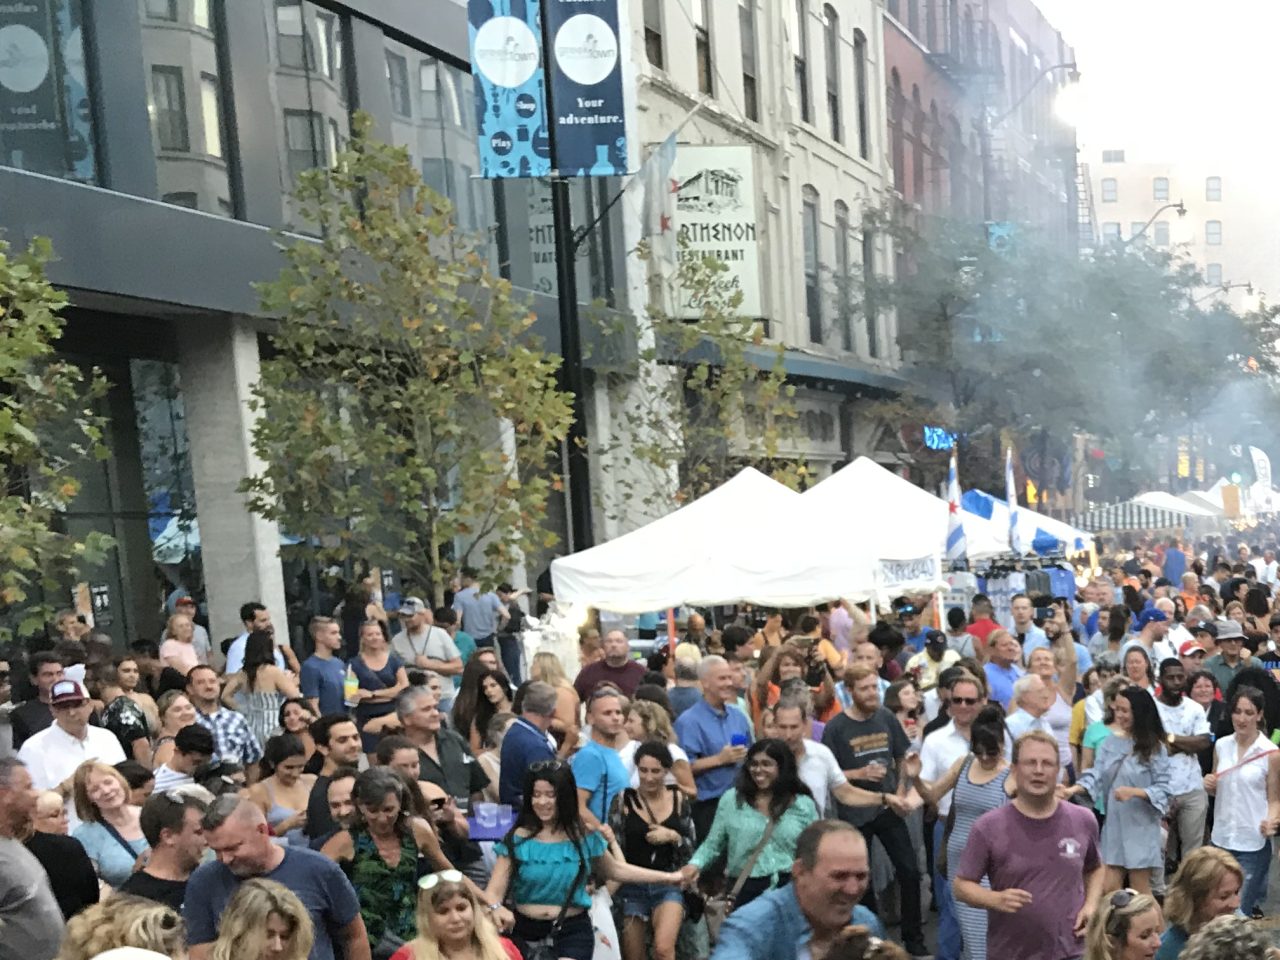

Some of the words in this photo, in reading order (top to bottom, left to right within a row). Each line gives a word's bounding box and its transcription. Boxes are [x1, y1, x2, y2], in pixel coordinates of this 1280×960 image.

[577, 97, 604, 108] Your
[558, 113, 623, 124] adventure.
[491, 138, 512, 149] Play
[680, 222, 757, 243] RTHENON
